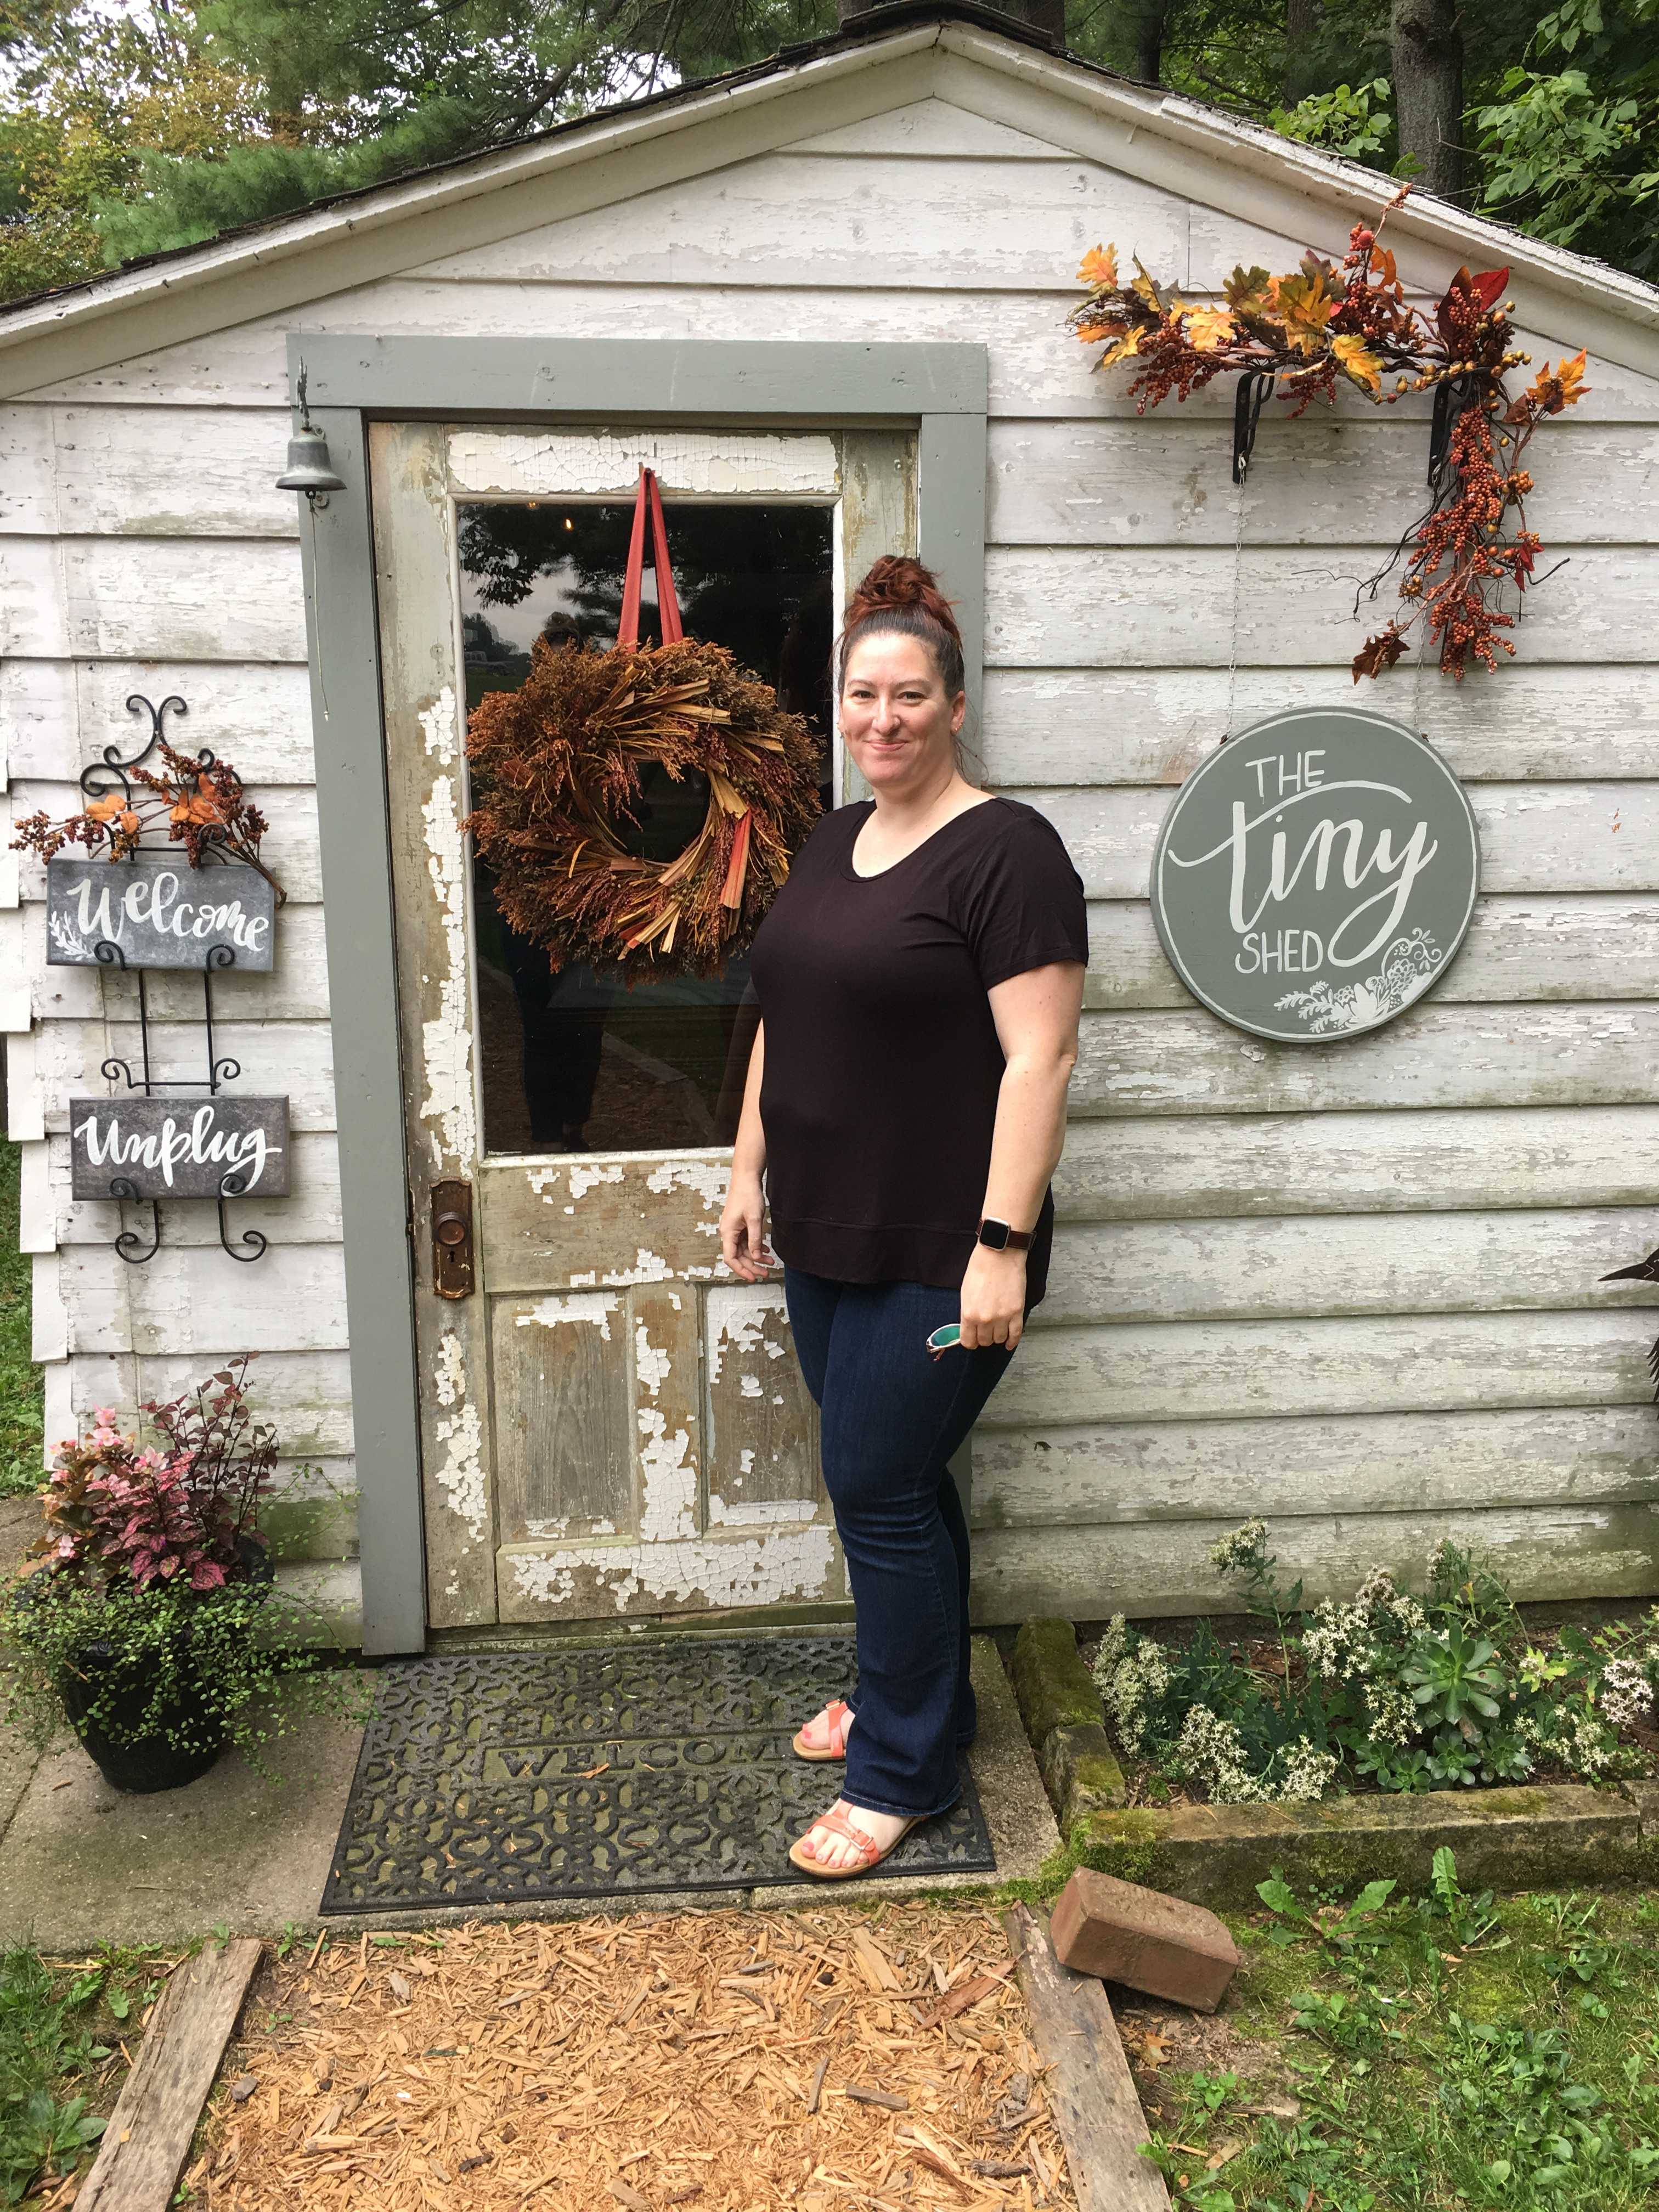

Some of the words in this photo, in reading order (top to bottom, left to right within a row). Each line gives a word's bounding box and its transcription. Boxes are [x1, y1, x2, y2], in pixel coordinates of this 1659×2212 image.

[1245, 749, 1325, 797] THE
[1168, 780, 1438, 967] tiny
[66, 872, 269, 951] Welcome
[1235, 929, 1323, 974] SHED
[74, 1105, 283, 1197] Unplug
[498, 1734, 794, 1777] WELCOM
